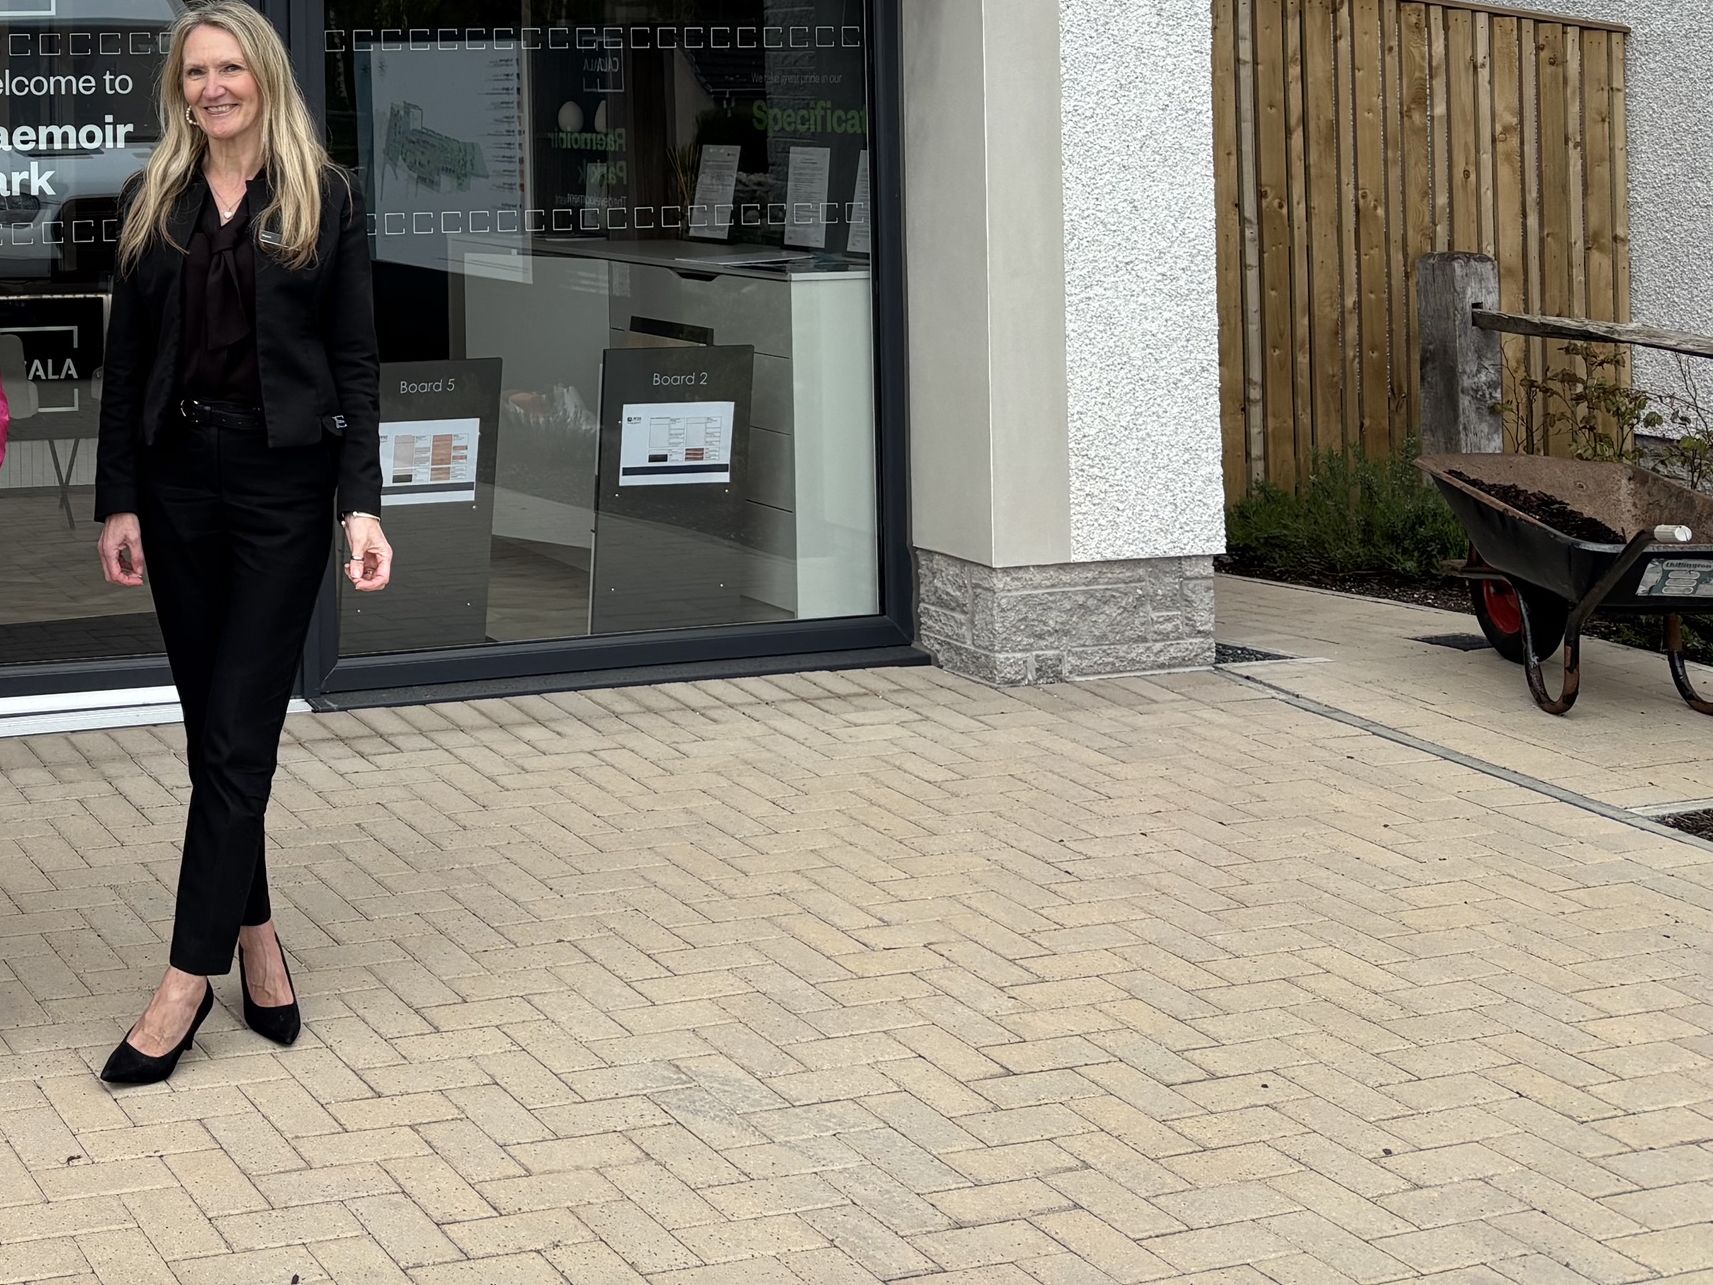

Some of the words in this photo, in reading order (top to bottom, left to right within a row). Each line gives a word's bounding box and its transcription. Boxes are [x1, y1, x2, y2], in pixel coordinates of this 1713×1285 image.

[103, 69, 134, 96] to
[24, 358, 79, 381] ALA
[652, 372, 696, 386] Board
[699, 371, 708, 385] 2
[400, 379, 443, 394] Board
[446, 378, 456, 392] 5
